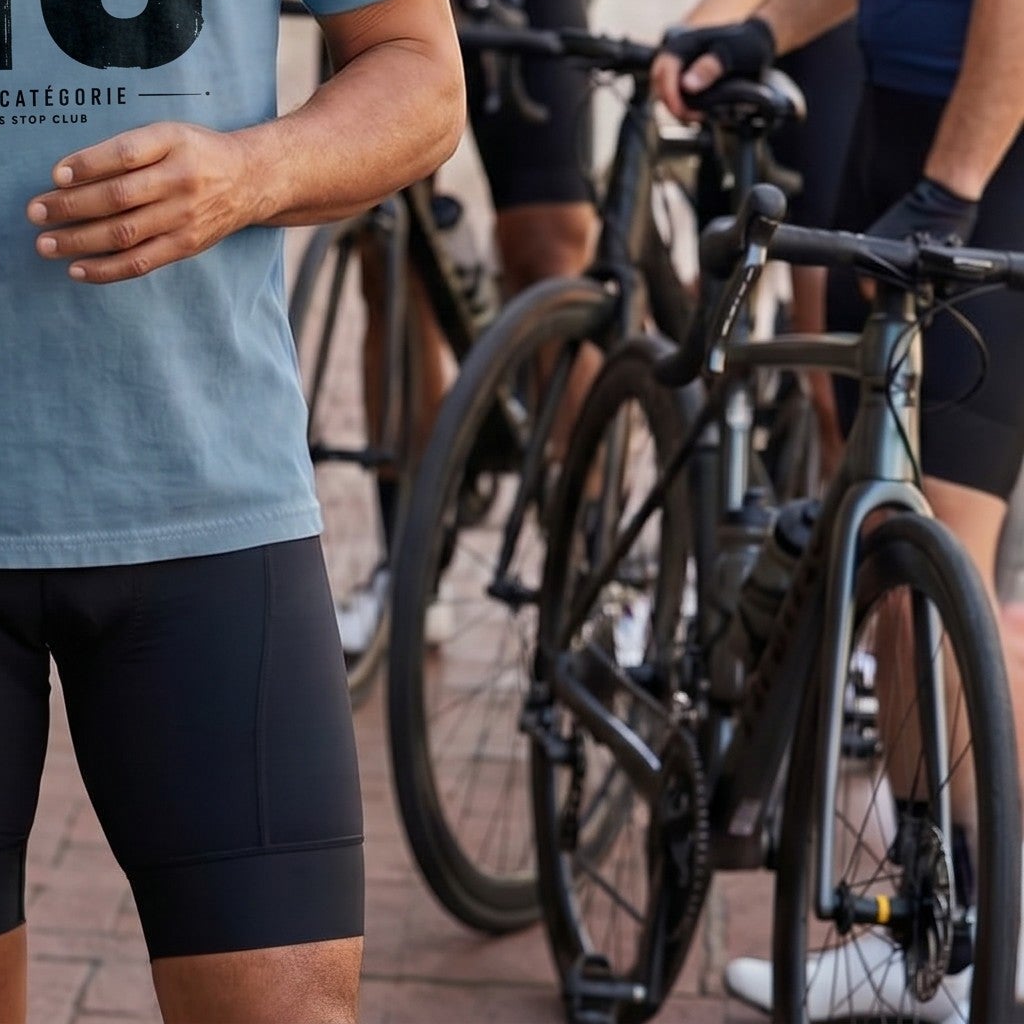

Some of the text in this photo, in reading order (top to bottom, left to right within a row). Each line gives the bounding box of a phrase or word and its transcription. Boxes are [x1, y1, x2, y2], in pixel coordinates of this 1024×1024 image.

[0, 85, 127, 108] CATÉGORIE
[11, 115, 47, 125] STOP
[52, 114, 88, 124] CLUB
